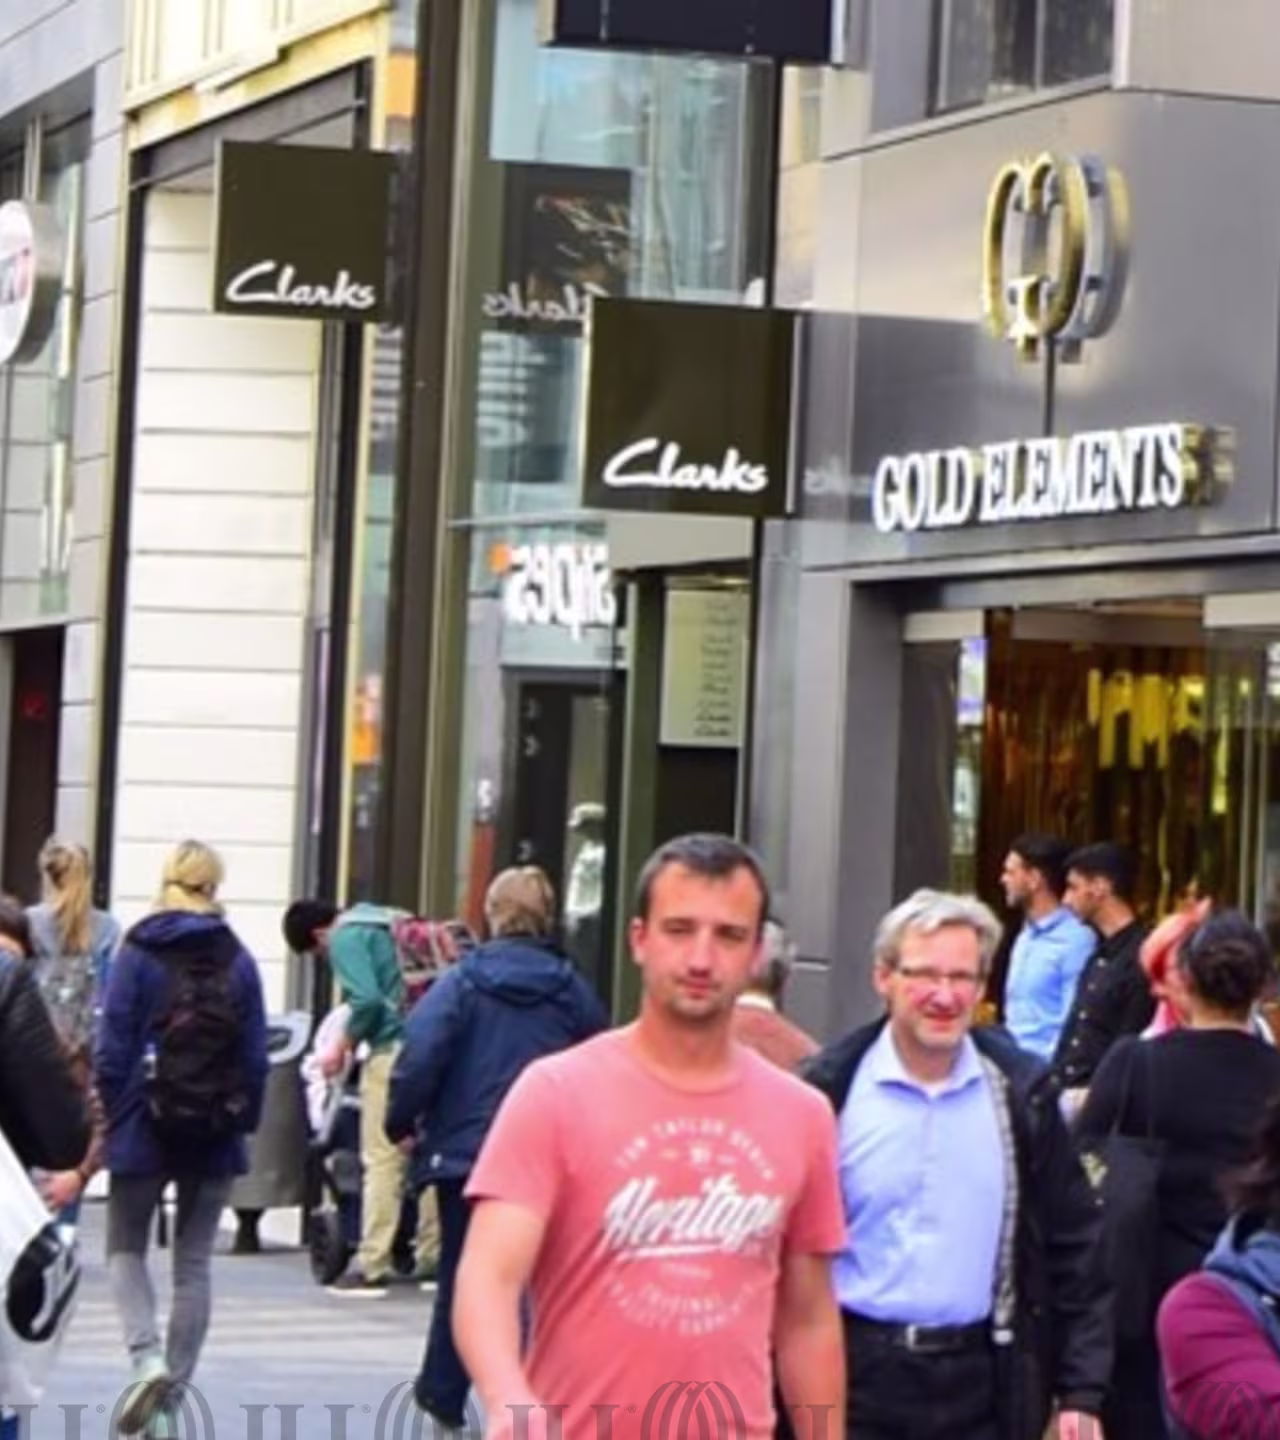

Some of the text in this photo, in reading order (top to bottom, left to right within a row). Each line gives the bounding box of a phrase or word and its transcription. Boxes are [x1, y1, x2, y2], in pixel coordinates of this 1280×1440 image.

[224, 258, 376, 310] Clarks
[601, 436, 769, 494] Clarks
[872, 447, 975, 534] GOLD
[978, 421, 1187, 523] ELEMENTS
[604, 1173, 786, 1253] Heritage
